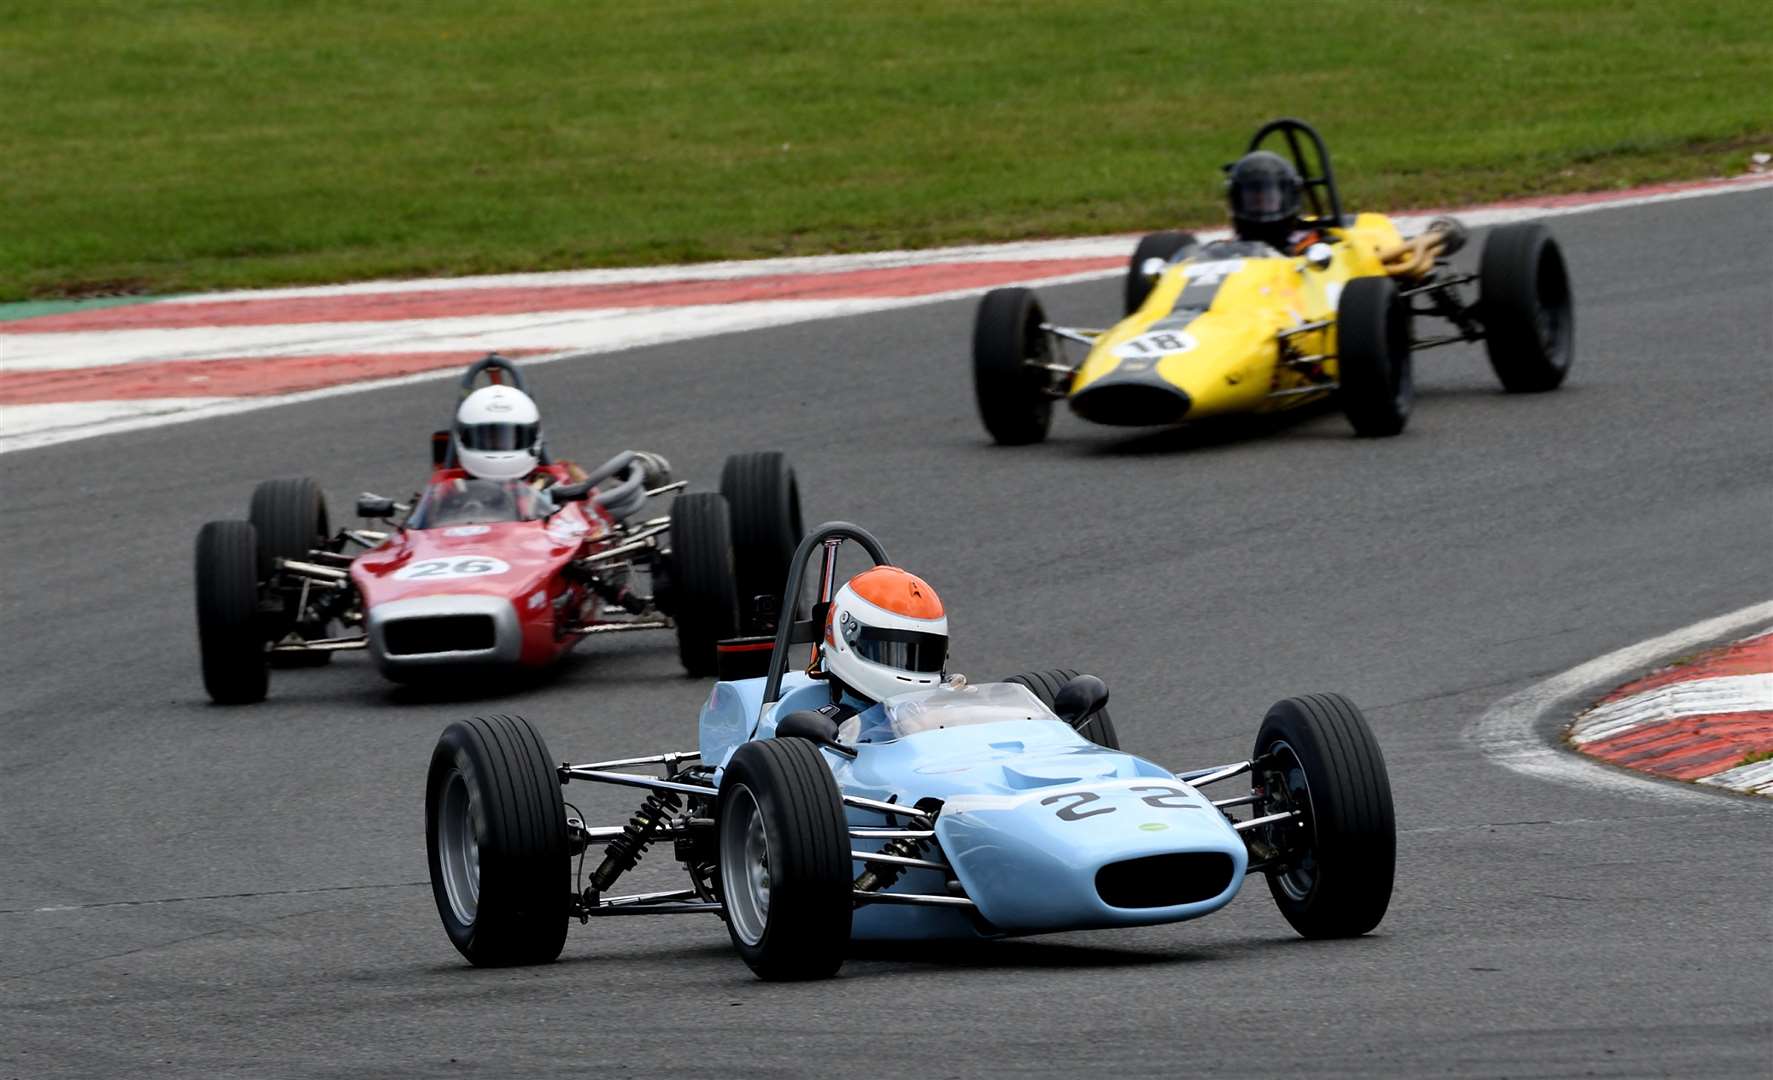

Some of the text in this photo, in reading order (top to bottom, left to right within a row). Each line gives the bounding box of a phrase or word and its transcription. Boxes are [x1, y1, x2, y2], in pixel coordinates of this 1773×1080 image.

[1128, 333, 1185, 353] 18
[408, 559, 494, 578] 26
[1040, 785, 1202, 822] 22
